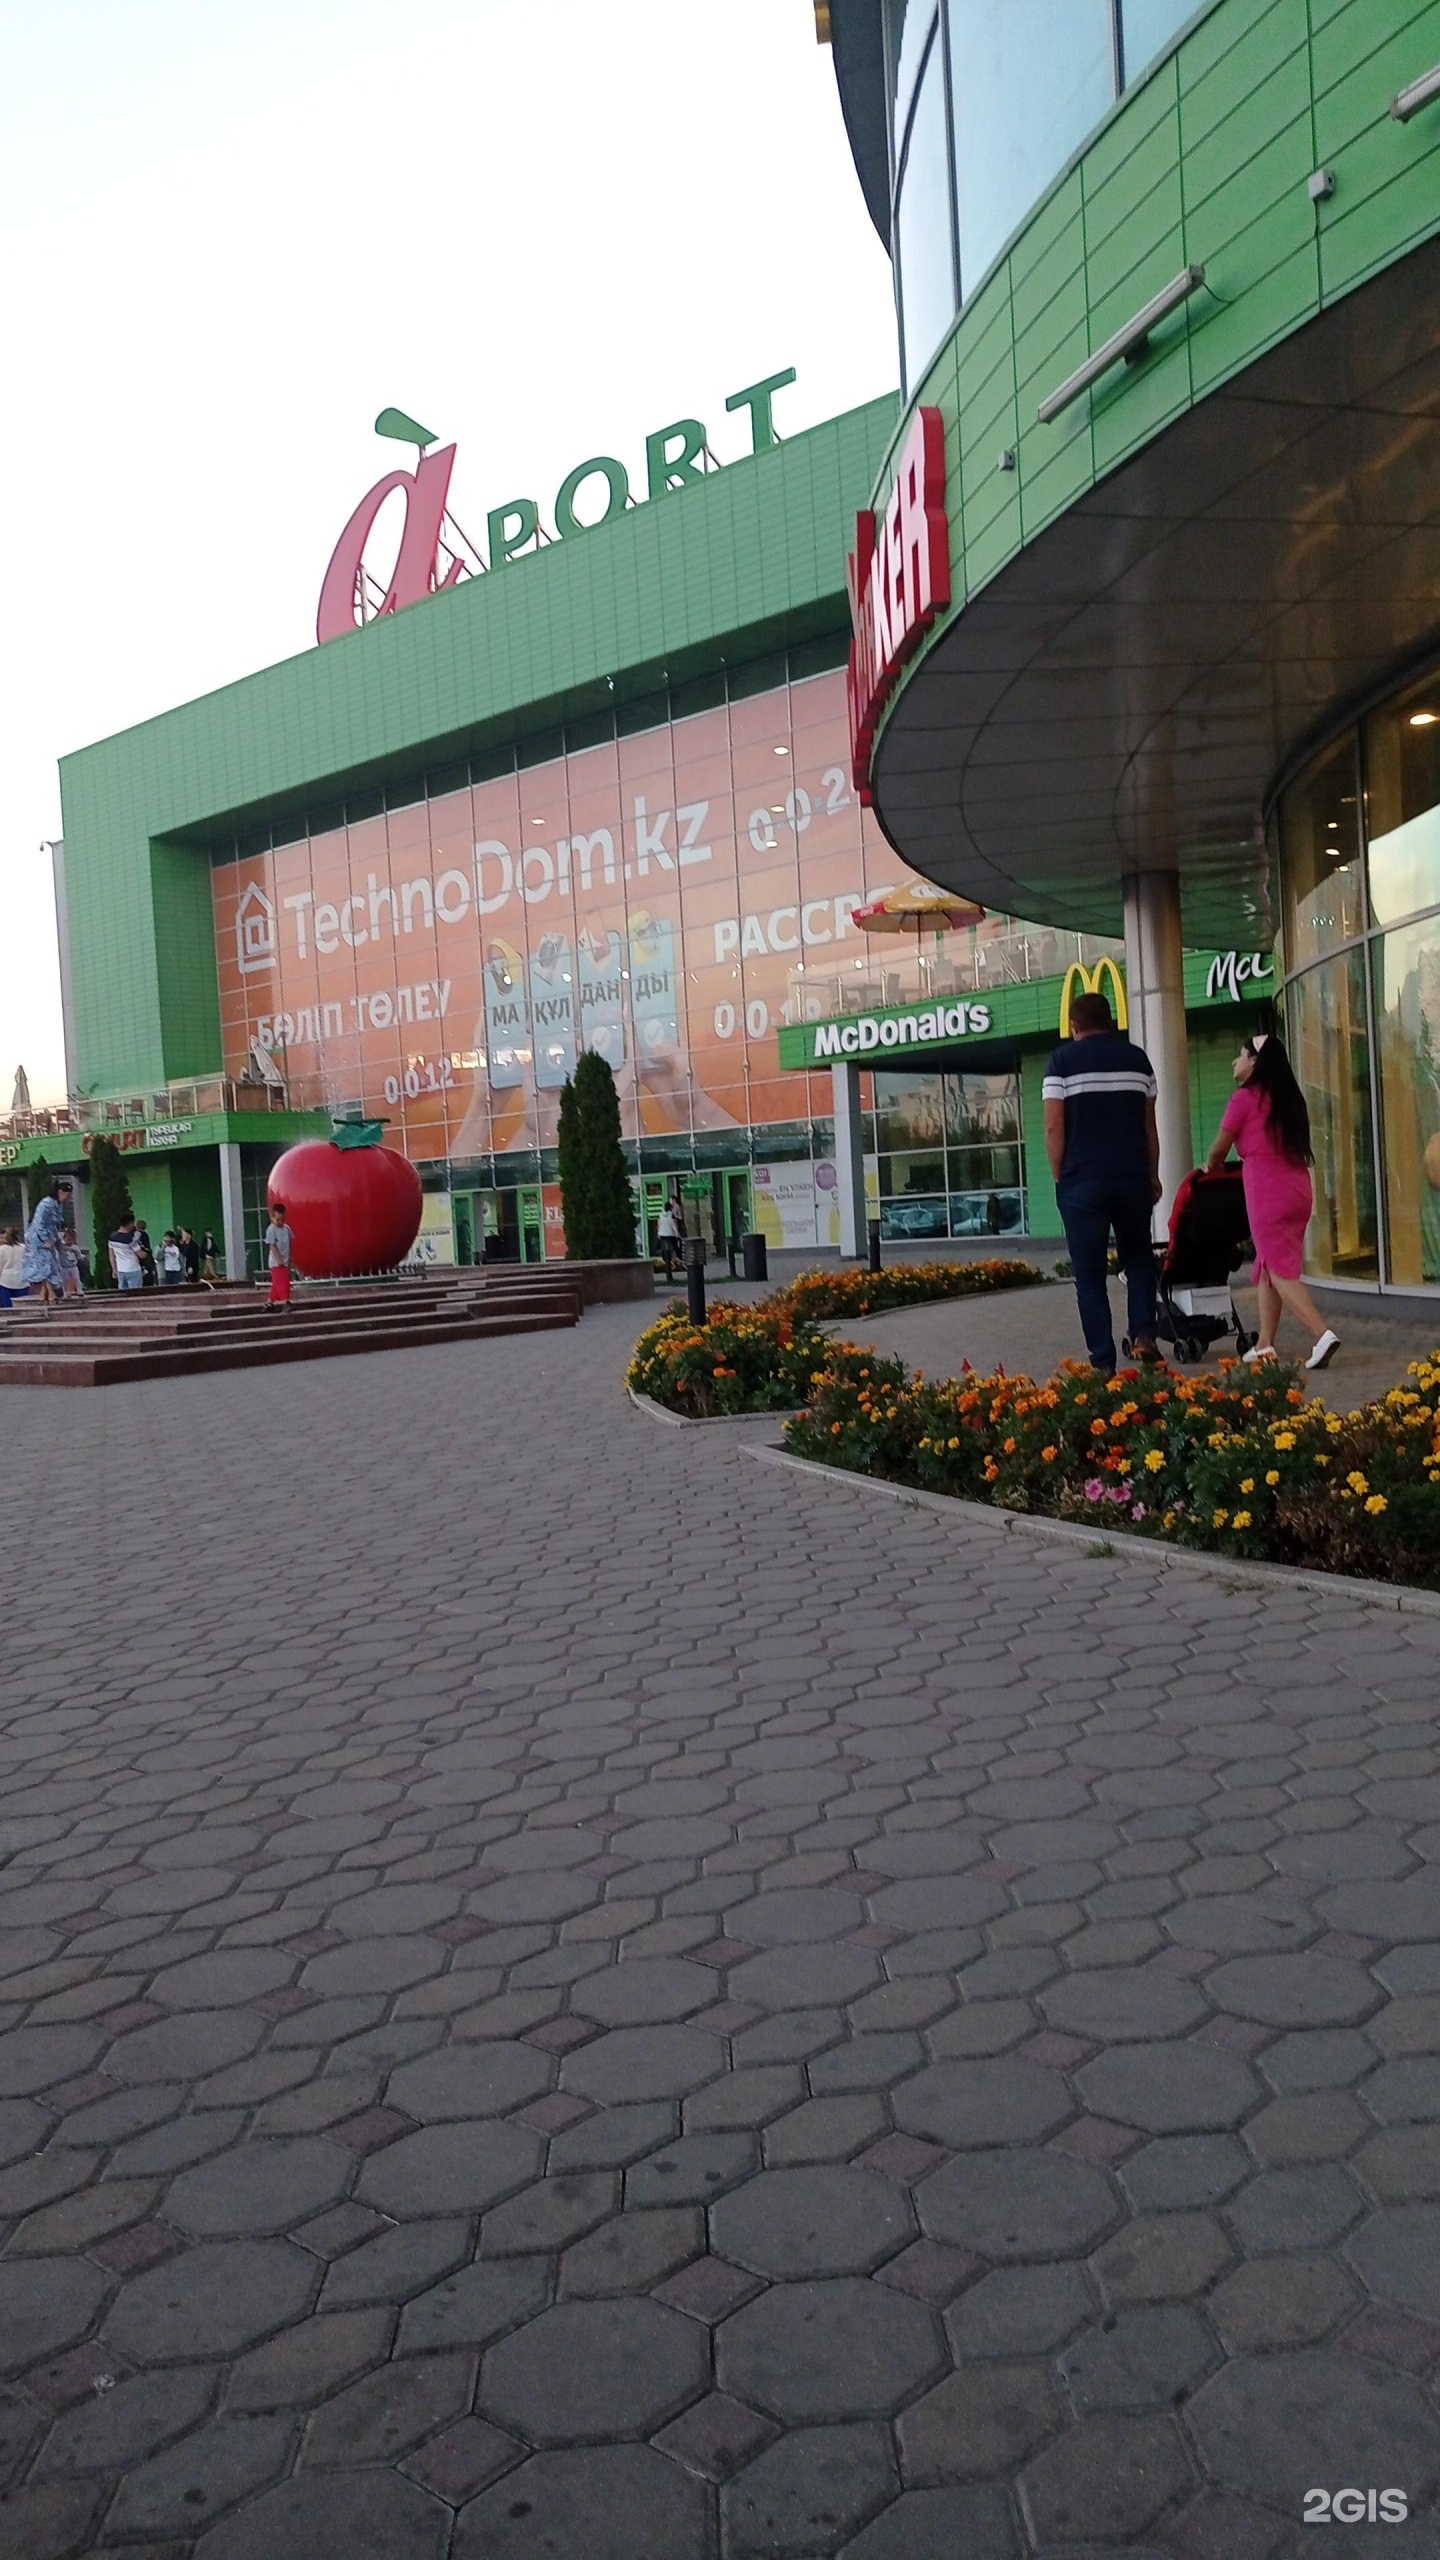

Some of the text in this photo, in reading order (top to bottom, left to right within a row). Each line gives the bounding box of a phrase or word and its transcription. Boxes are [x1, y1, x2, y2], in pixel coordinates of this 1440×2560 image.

[283, 795, 713, 959] TechnoDom.kz
[256, 979, 452, 1051] БӨЛІП ТӨЛЕУ
[492, 1003, 520, 1027] МА
[581, 979, 620, 1008] ДАН
[635, 971, 669, 1001] ДЫ
[814, 1001, 993, 1058] McDonald's
